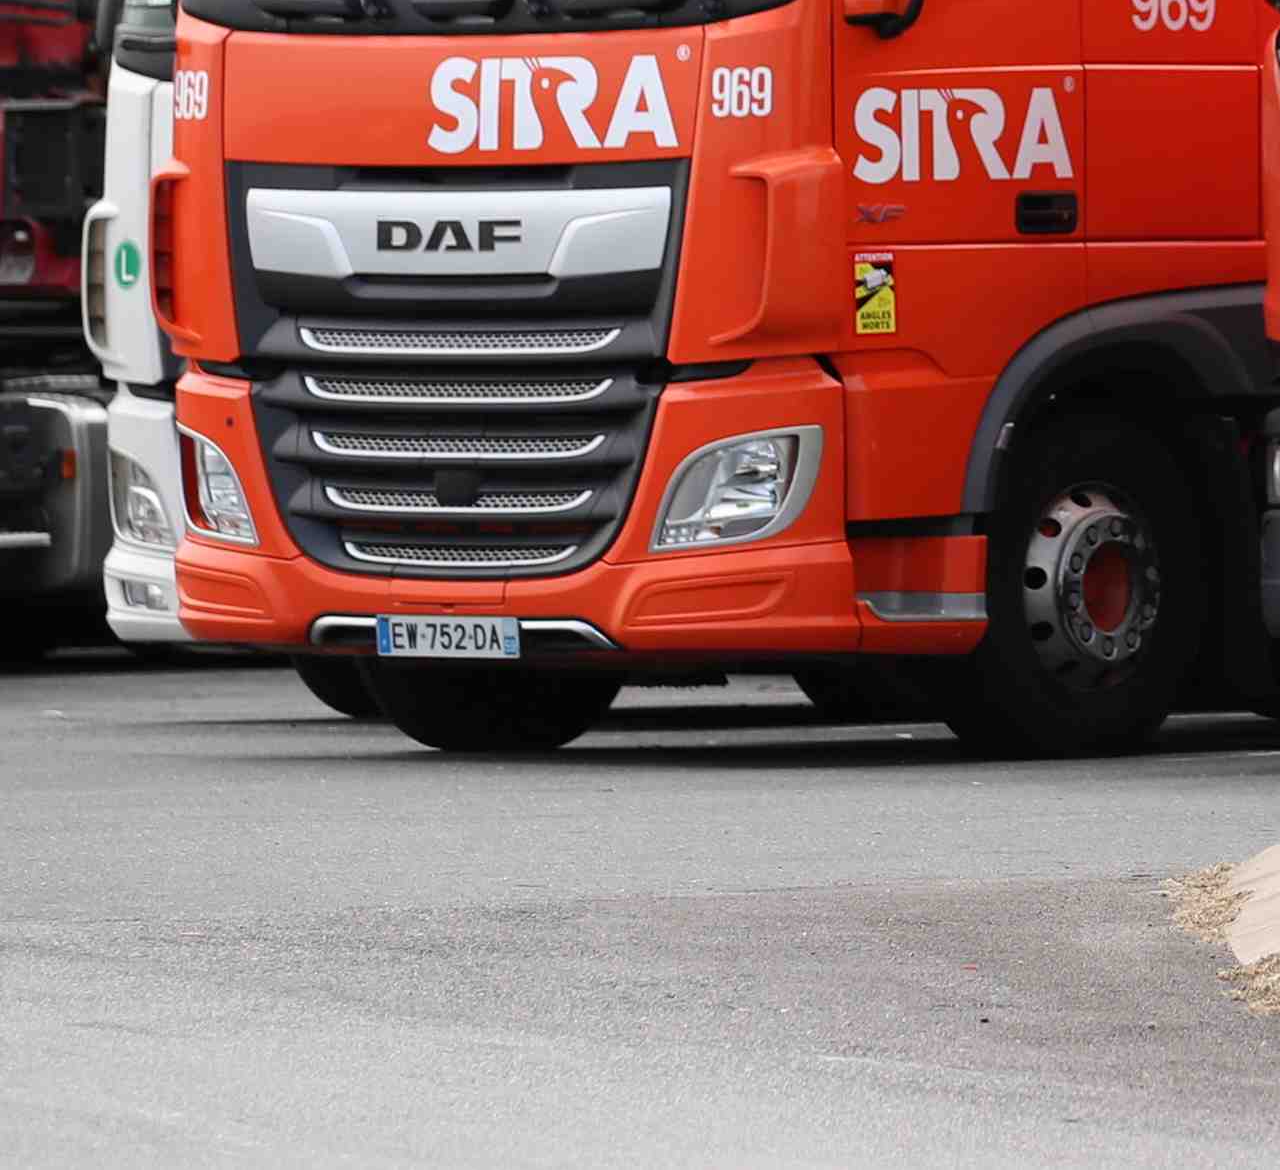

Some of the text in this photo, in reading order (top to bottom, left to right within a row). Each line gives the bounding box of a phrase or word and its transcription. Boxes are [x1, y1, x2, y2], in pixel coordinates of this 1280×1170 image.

[175, 70, 209, 120] 969
[427, 55, 679, 154] SITRA
[711, 66, 772, 118] 969
[852, 87, 1073, 185] SITRA
[376, 220, 521, 252] DAF
[121, 248, 135, 280] L
